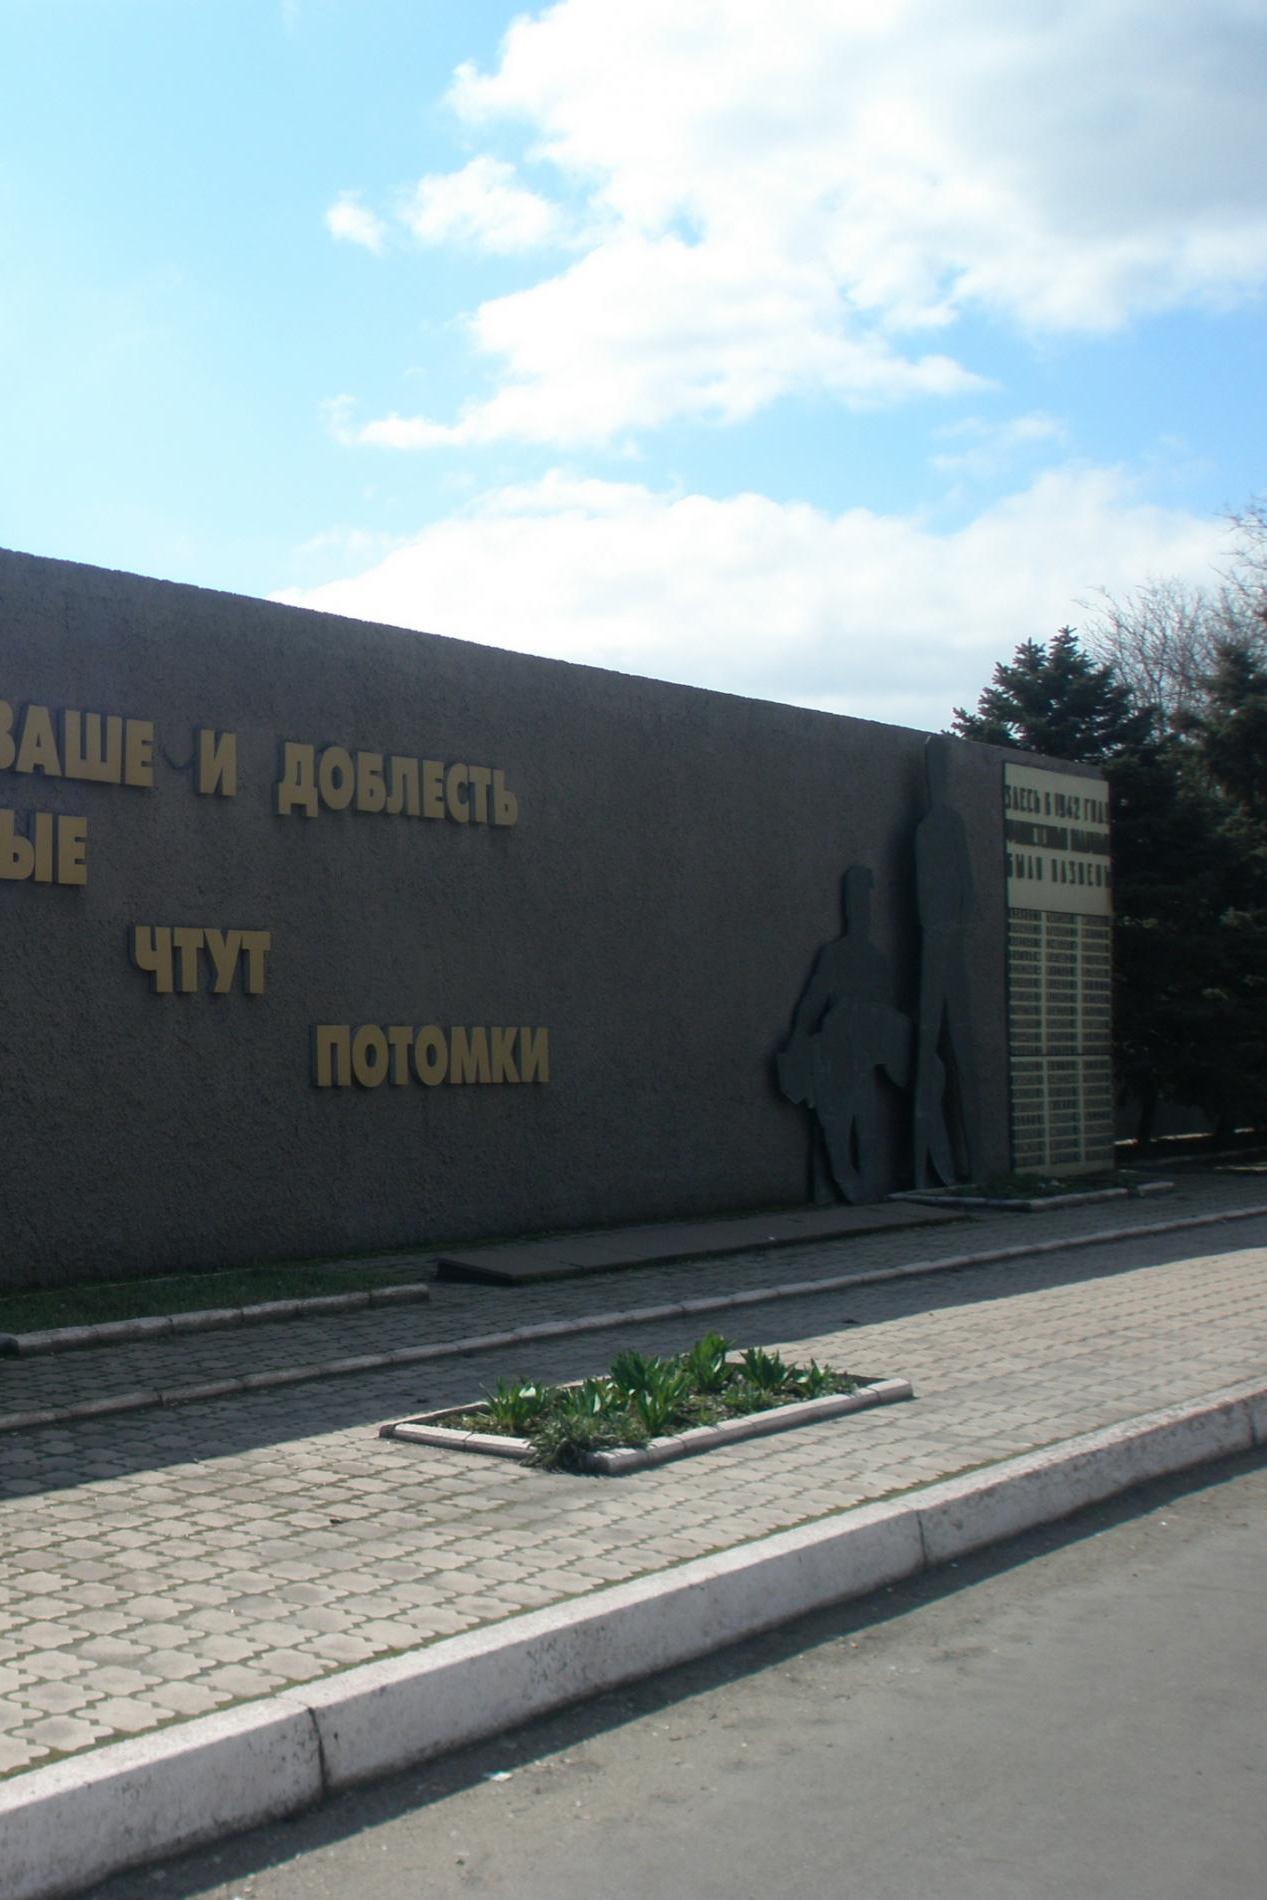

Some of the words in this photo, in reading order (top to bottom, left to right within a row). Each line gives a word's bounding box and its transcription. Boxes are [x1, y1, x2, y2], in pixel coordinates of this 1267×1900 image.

[199, 729, 235, 797] И
[278, 741, 519, 827] ДОБЛЕСТЬ
[135, 925, 271, 994] ЧТУТ
[316, 1024, 550, 1088] ПОТОМКИ
